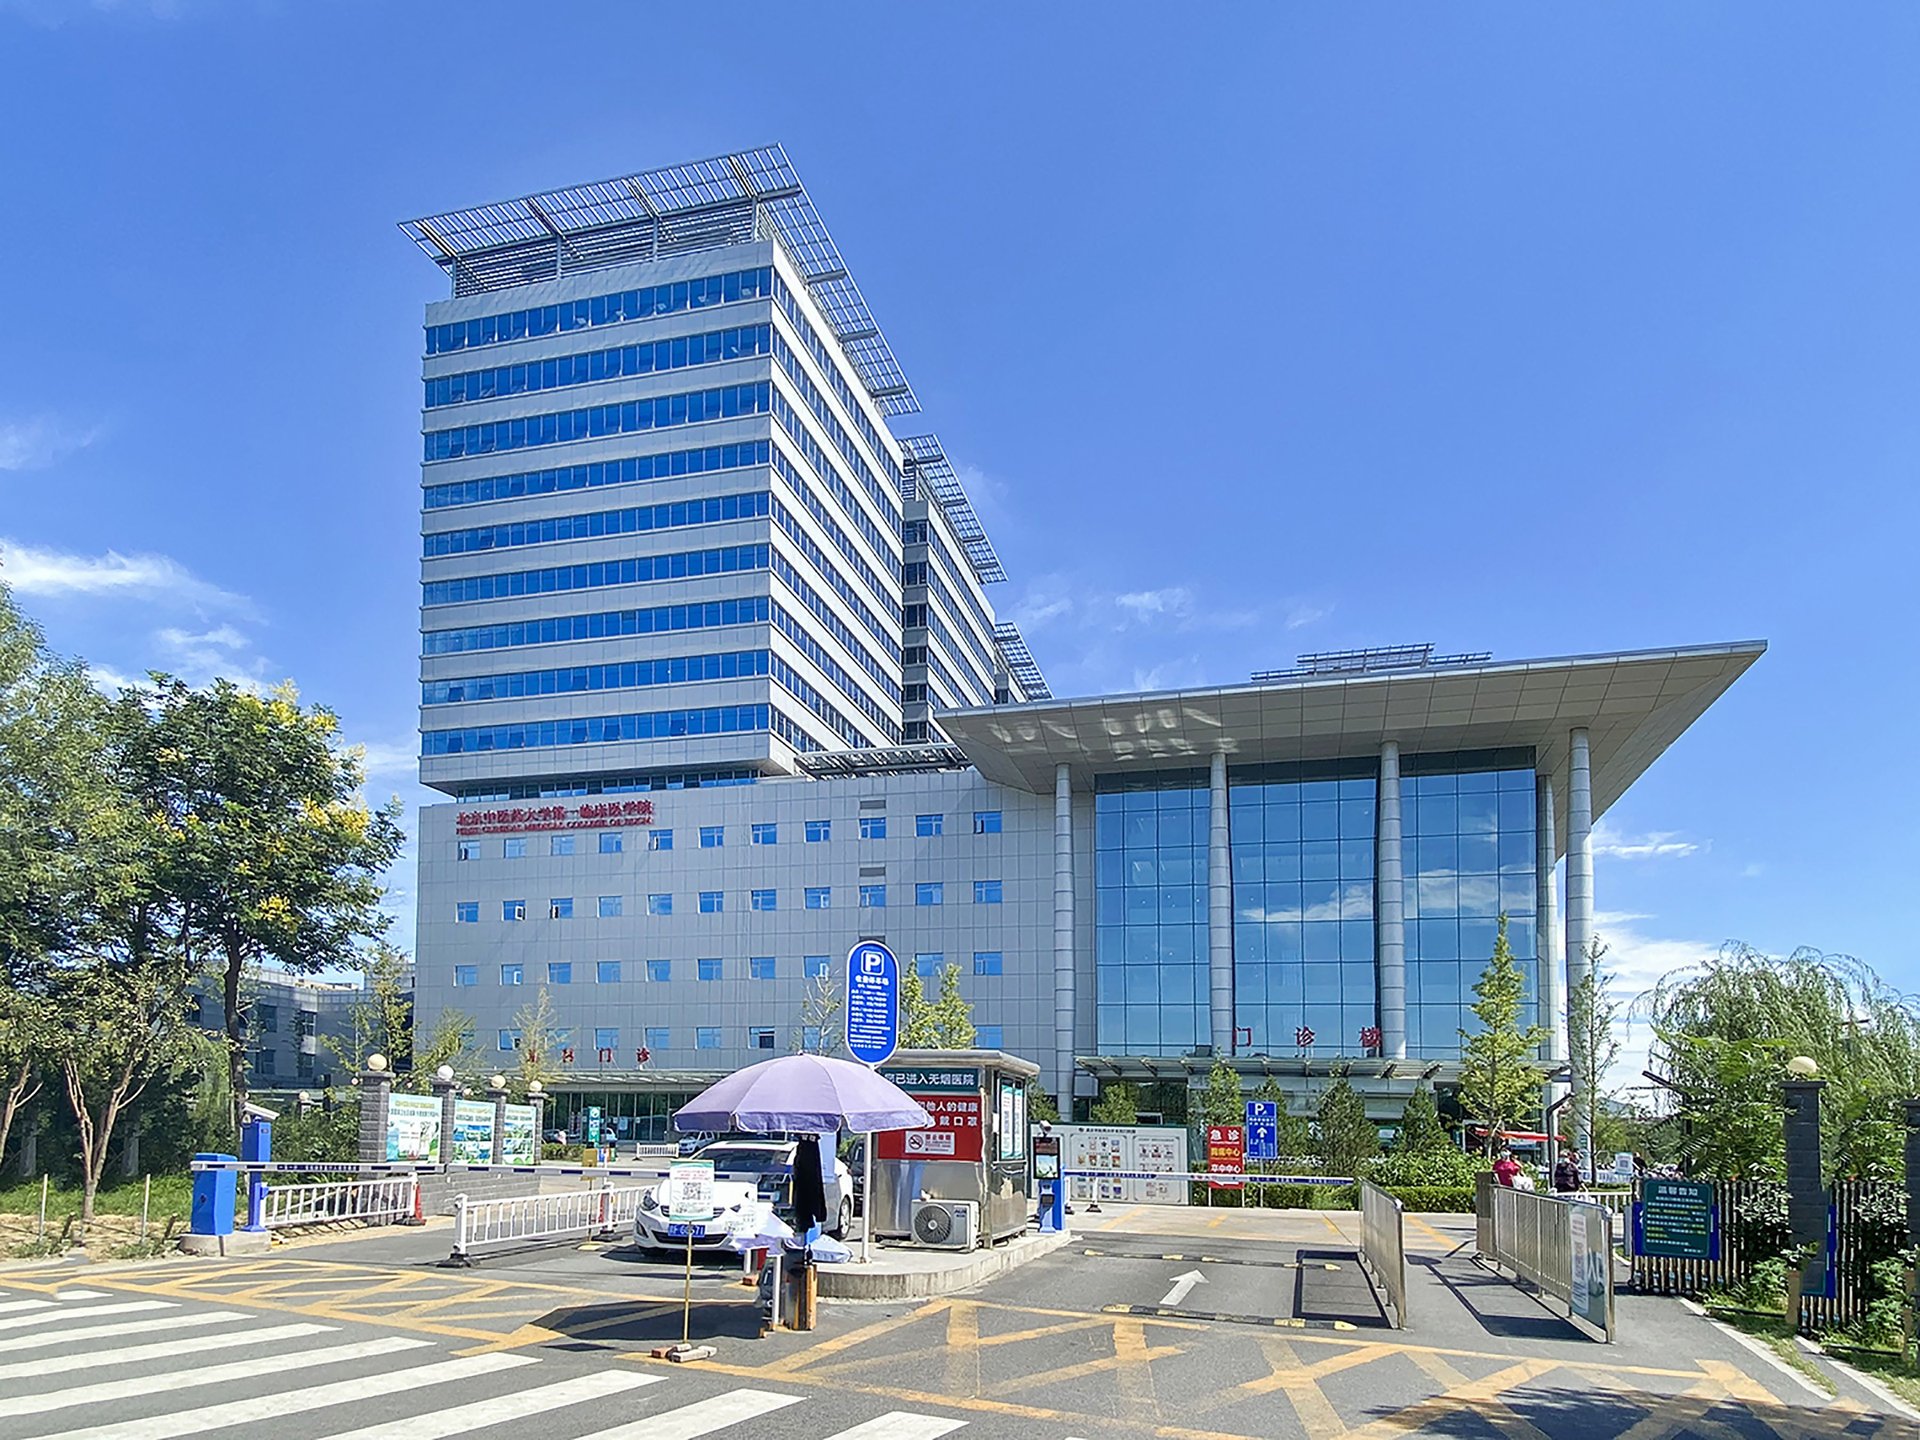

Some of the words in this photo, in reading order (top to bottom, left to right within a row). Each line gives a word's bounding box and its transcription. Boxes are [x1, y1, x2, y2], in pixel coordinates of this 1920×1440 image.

[456, 800, 653, 826] 北京中医药大学第一临床医学院
[865, 953, 881, 971] P
[1255, 1103, 1264, 1115] P
[1210, 1129, 1240, 1141] 急诊
